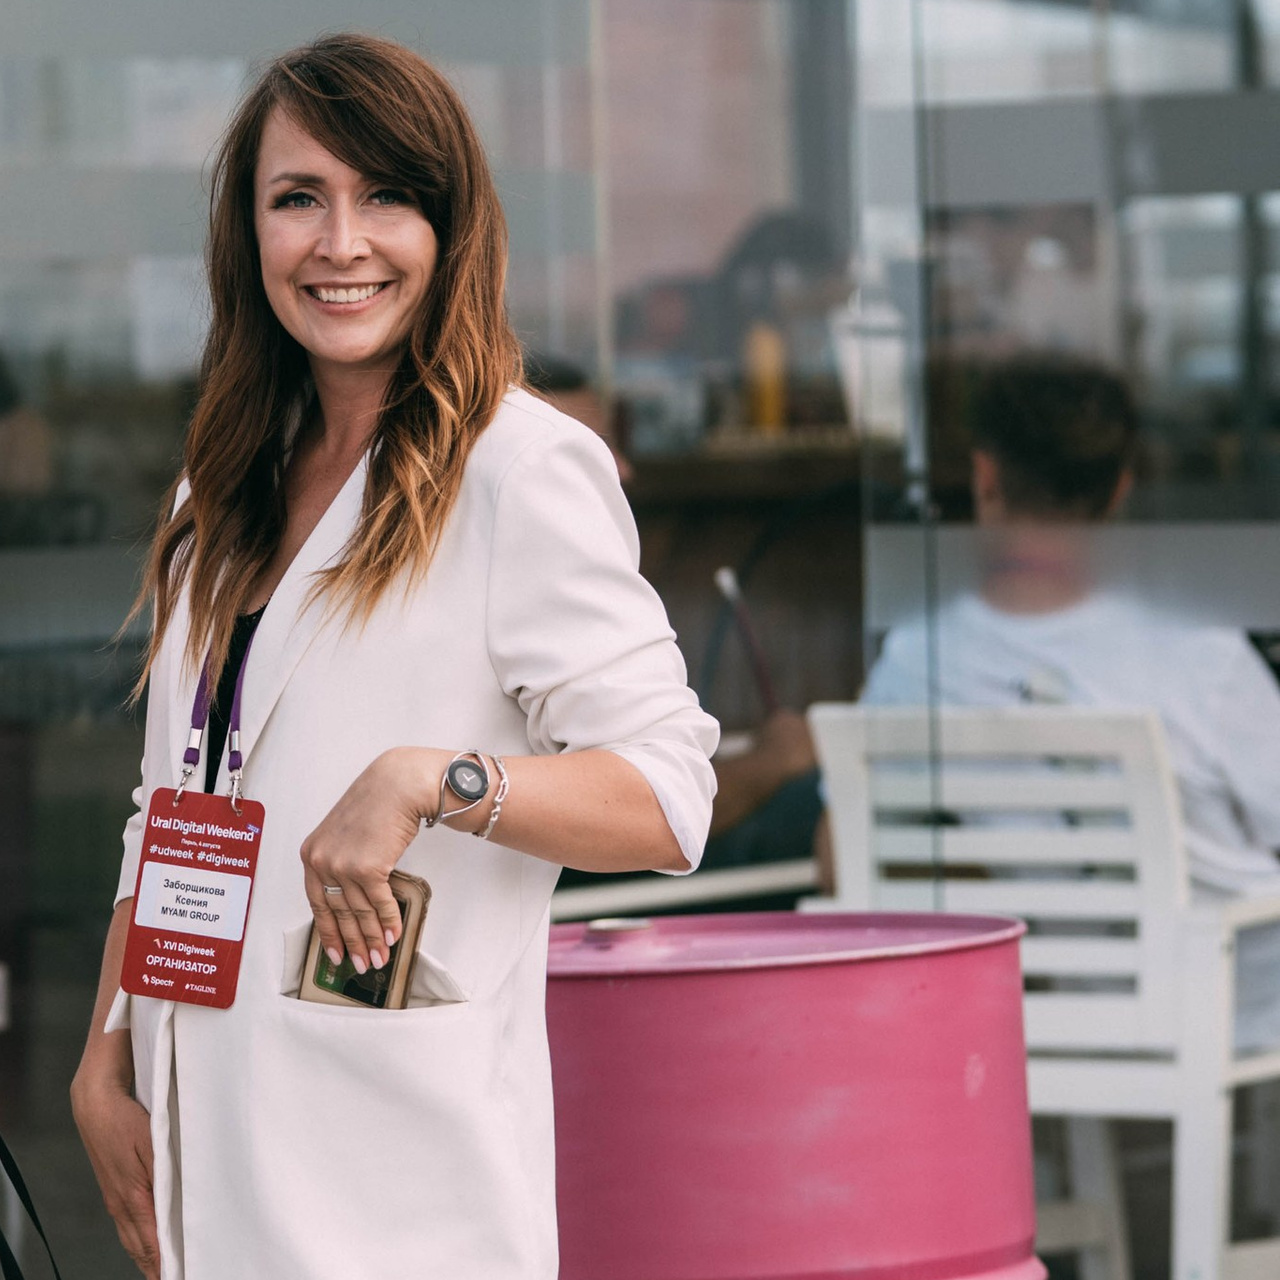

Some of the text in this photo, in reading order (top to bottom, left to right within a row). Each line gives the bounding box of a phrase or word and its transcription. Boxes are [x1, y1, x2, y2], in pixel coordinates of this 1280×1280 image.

[151, 816, 254, 841] Ural Digital Weekend
[150, 844, 250, 868] #udweek #digiweek
[164, 879, 225, 896] Заборщикова
[175, 895, 208, 907] Ксения
[161, 907, 220, 922] MYAMI GROUP
[163, 940, 215, 957] XVI Digiweek
[146, 955, 216, 974] ОРГАНИЗАТОР
[151, 976, 174, 987] Spectr
[189, 984, 216, 994] TAGLINE
